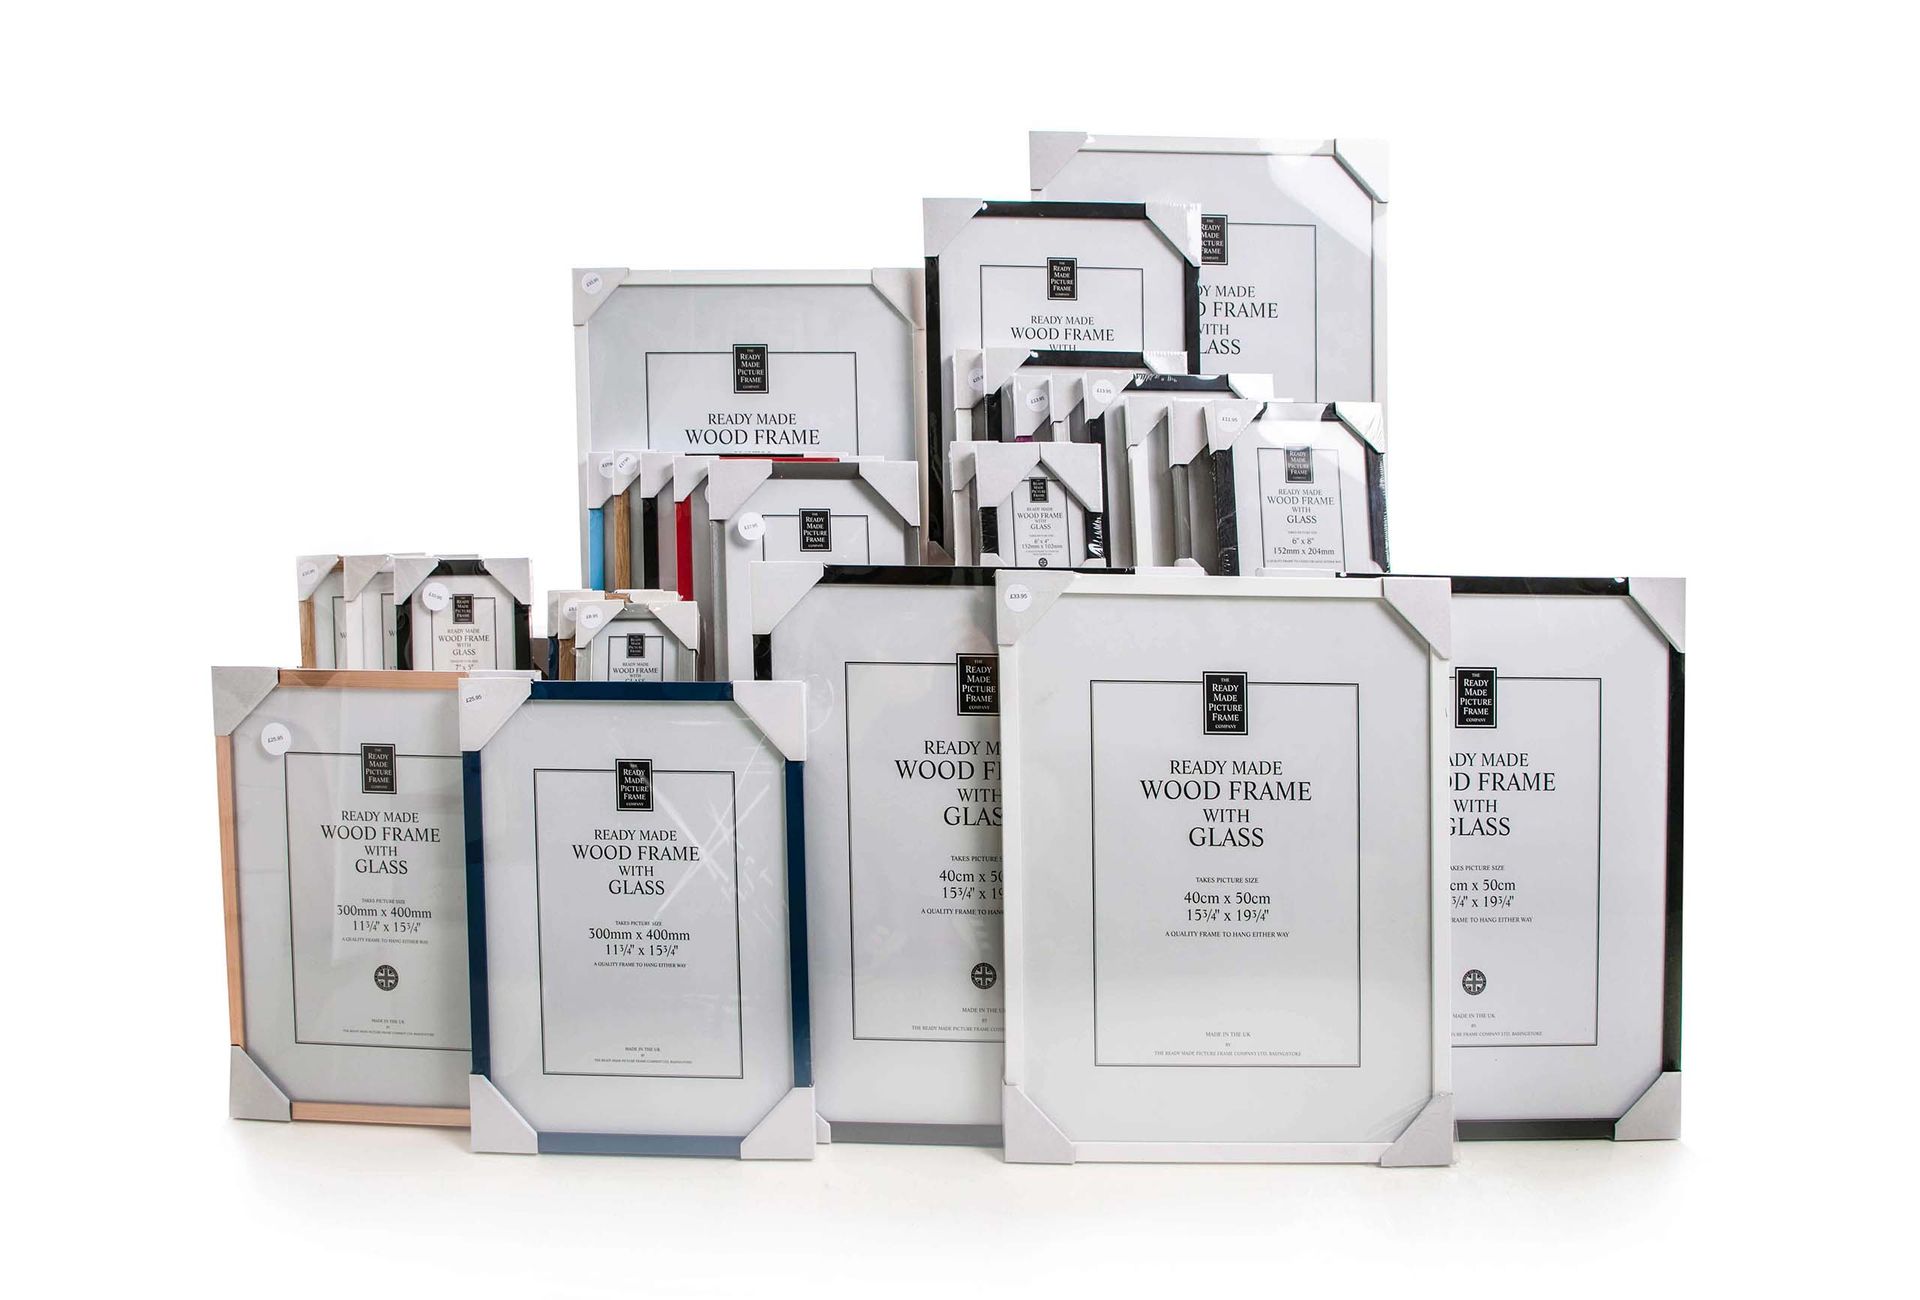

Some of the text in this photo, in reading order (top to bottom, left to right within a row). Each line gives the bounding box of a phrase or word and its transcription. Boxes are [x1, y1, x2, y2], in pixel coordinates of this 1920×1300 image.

[1215, 286, 1256, 298] MADE
[1213, 302, 1279, 319] FRAME
[1031, 315, 1094, 325] READY MADE
[1011, 327, 1115, 341] WOOD FRAME
[708, 413, 797, 425] READY MADE
[685, 429, 820, 445] WOOD FRAME
[1267, 496, 1335, 505] WOOD FRAME
[1286, 515, 1317, 524] GLASS
[1273, 547, 1300, 555] 152mm
[965, 665, 992, 674] READY
[967, 674, 991, 683] MADE
[1463, 678, 1489, 687] READY
[962, 684, 996, 693] PICTURE
[1212, 683, 1239, 692] READY
[1464, 688, 1488, 696] MADE
[965, 694, 993, 703] FRAME
[1213, 693, 1238, 702] MADE
[1460, 697, 1492, 706] PICTURE
[1208, 703, 1243, 712] PICTURE
[1463, 707, 1489, 715] FRAME
[1212, 713, 1239, 722] FRAME
[924, 740, 981, 755] READY
[369, 760, 388, 768] MADE
[1481, 753, 1529, 767] MADE
[366, 768, 392, 776] PICTURE
[895, 760, 975, 780] WOOD
[1170, 760, 1283, 776] READY MADE
[368, 776, 390, 784] FRAME
[624, 776, 645, 784] MADE
[1478, 772, 1556, 791] FRAME
[957, 788, 1002, 803] WITH
[1140, 779, 1312, 801] WOOD FRAME
[1454, 799, 1497, 813] WITH
[341, 810, 419, 823] READY MADE
[1203, 808, 1250, 823] WITH
[321, 825, 441, 843] WOOD FRAME
[594, 829, 677, 841] READY MADE
[1189, 827, 1264, 847] GLASS
[364, 845, 398, 857] WITH
[572, 844, 701, 862] WOOD FRAME
[355, 859, 408, 874] GLASS
[619, 865, 654, 877] WITH
[939, 870, 974, 882] 40cm
[608, 880, 665, 895] GLASS
[1482, 879, 1516, 891] 50cm
[1184, 891, 1271, 905] 40cm x 50cm
[337, 905, 432, 919] 300mm x 400mm
[1224, 912, 1231, 921] x
[588, 927, 690, 941] 300mm x 400mm
[1170, 930, 1197, 938] QUALITY
